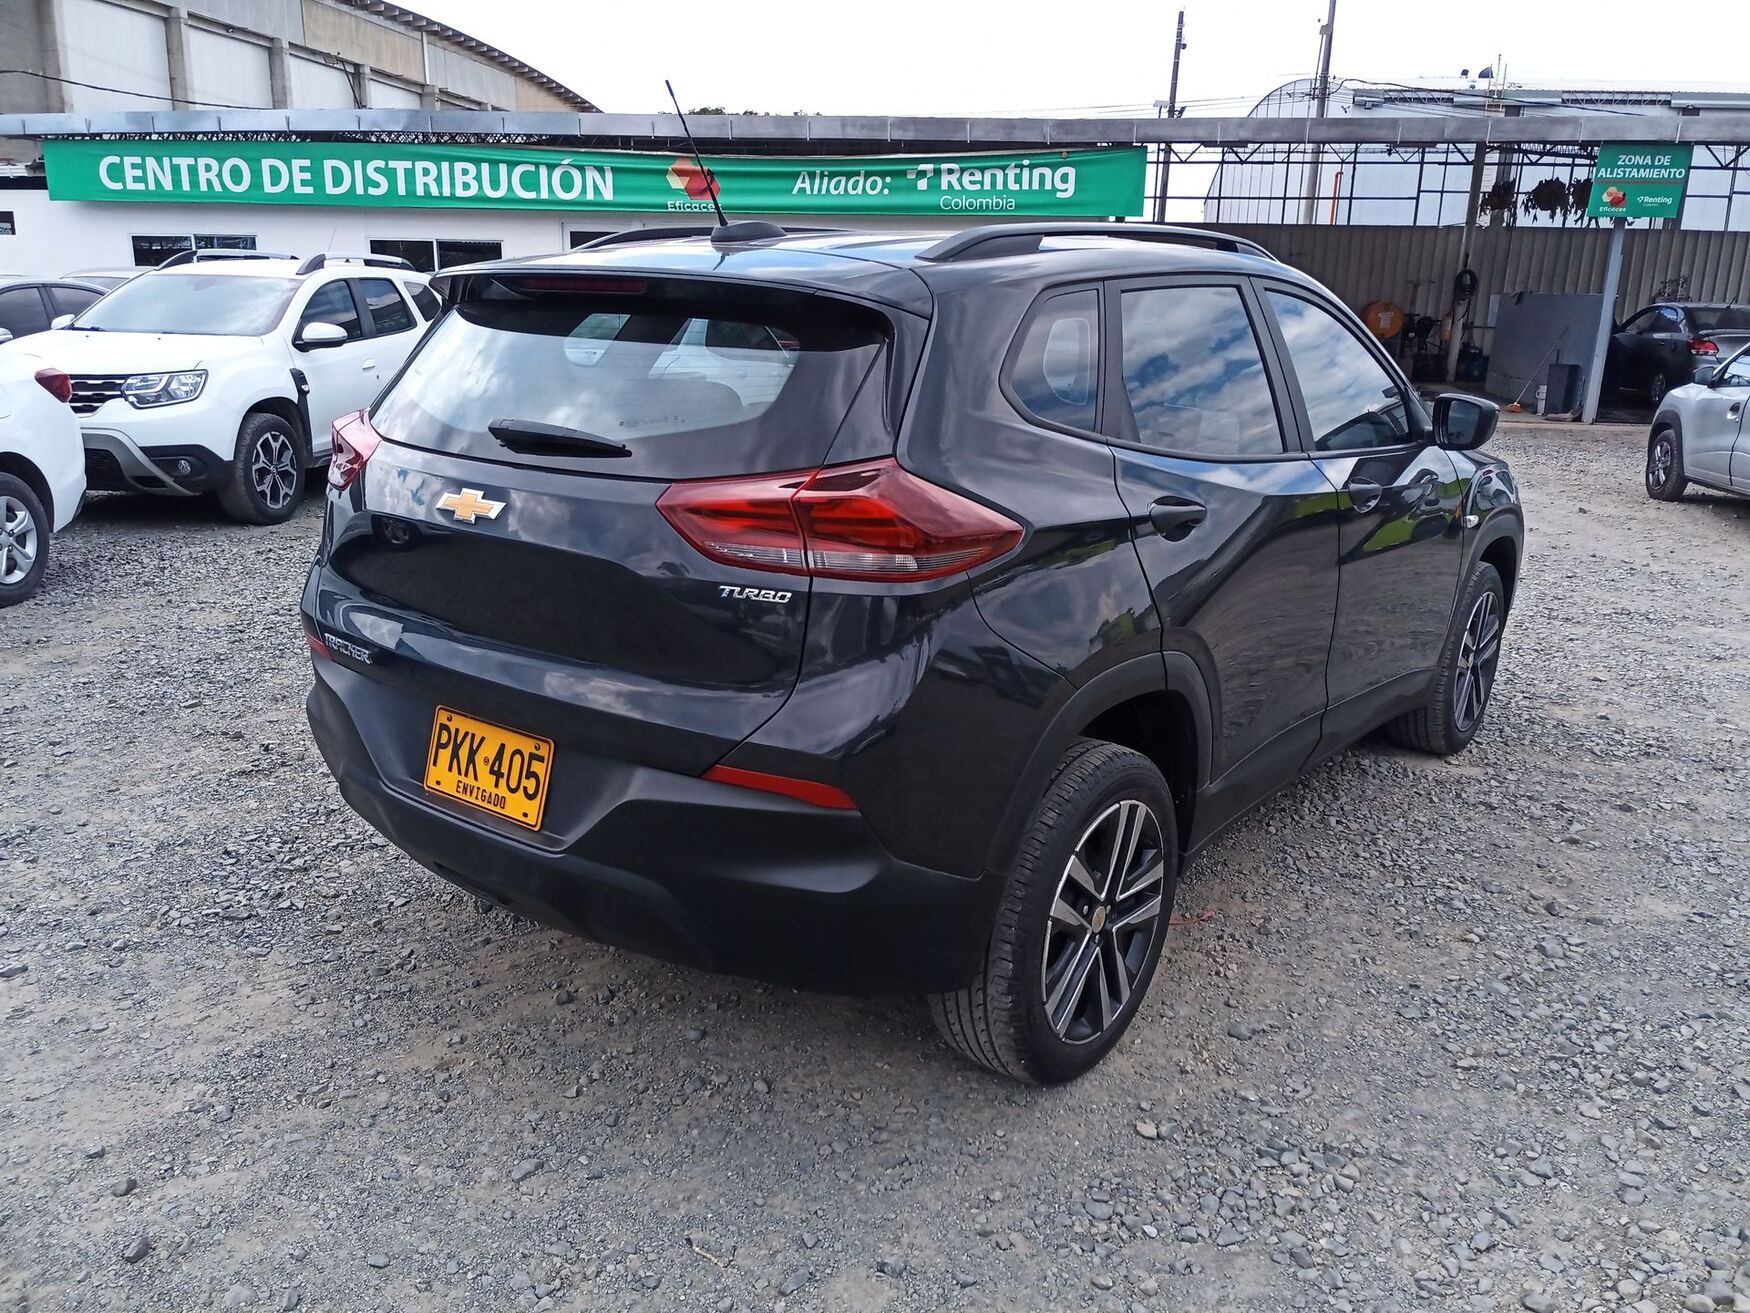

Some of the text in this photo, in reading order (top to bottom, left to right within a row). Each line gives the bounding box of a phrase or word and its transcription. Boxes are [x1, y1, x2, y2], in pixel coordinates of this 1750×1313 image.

[1617, 155, 1672, 166] ZONA DE
[99, 155, 615, 201] CENTRO DE DISTRIBUCIÓN
[792, 170, 892, 196] Aliado:
[940, 160, 1077, 198] Renting
[1597, 168, 1686, 179] ALISTAMIENTO
[667, 200, 722, 212] Eficace
[940, 195, 1016, 210] Colombia
[1643, 196, 1673, 205] Renting
[718, 585, 793, 603] TURBO
[324, 633, 372, 664] TRACKER
[432, 722, 545, 801] PKK 405
[455, 780, 507, 810] ENVIGADO
